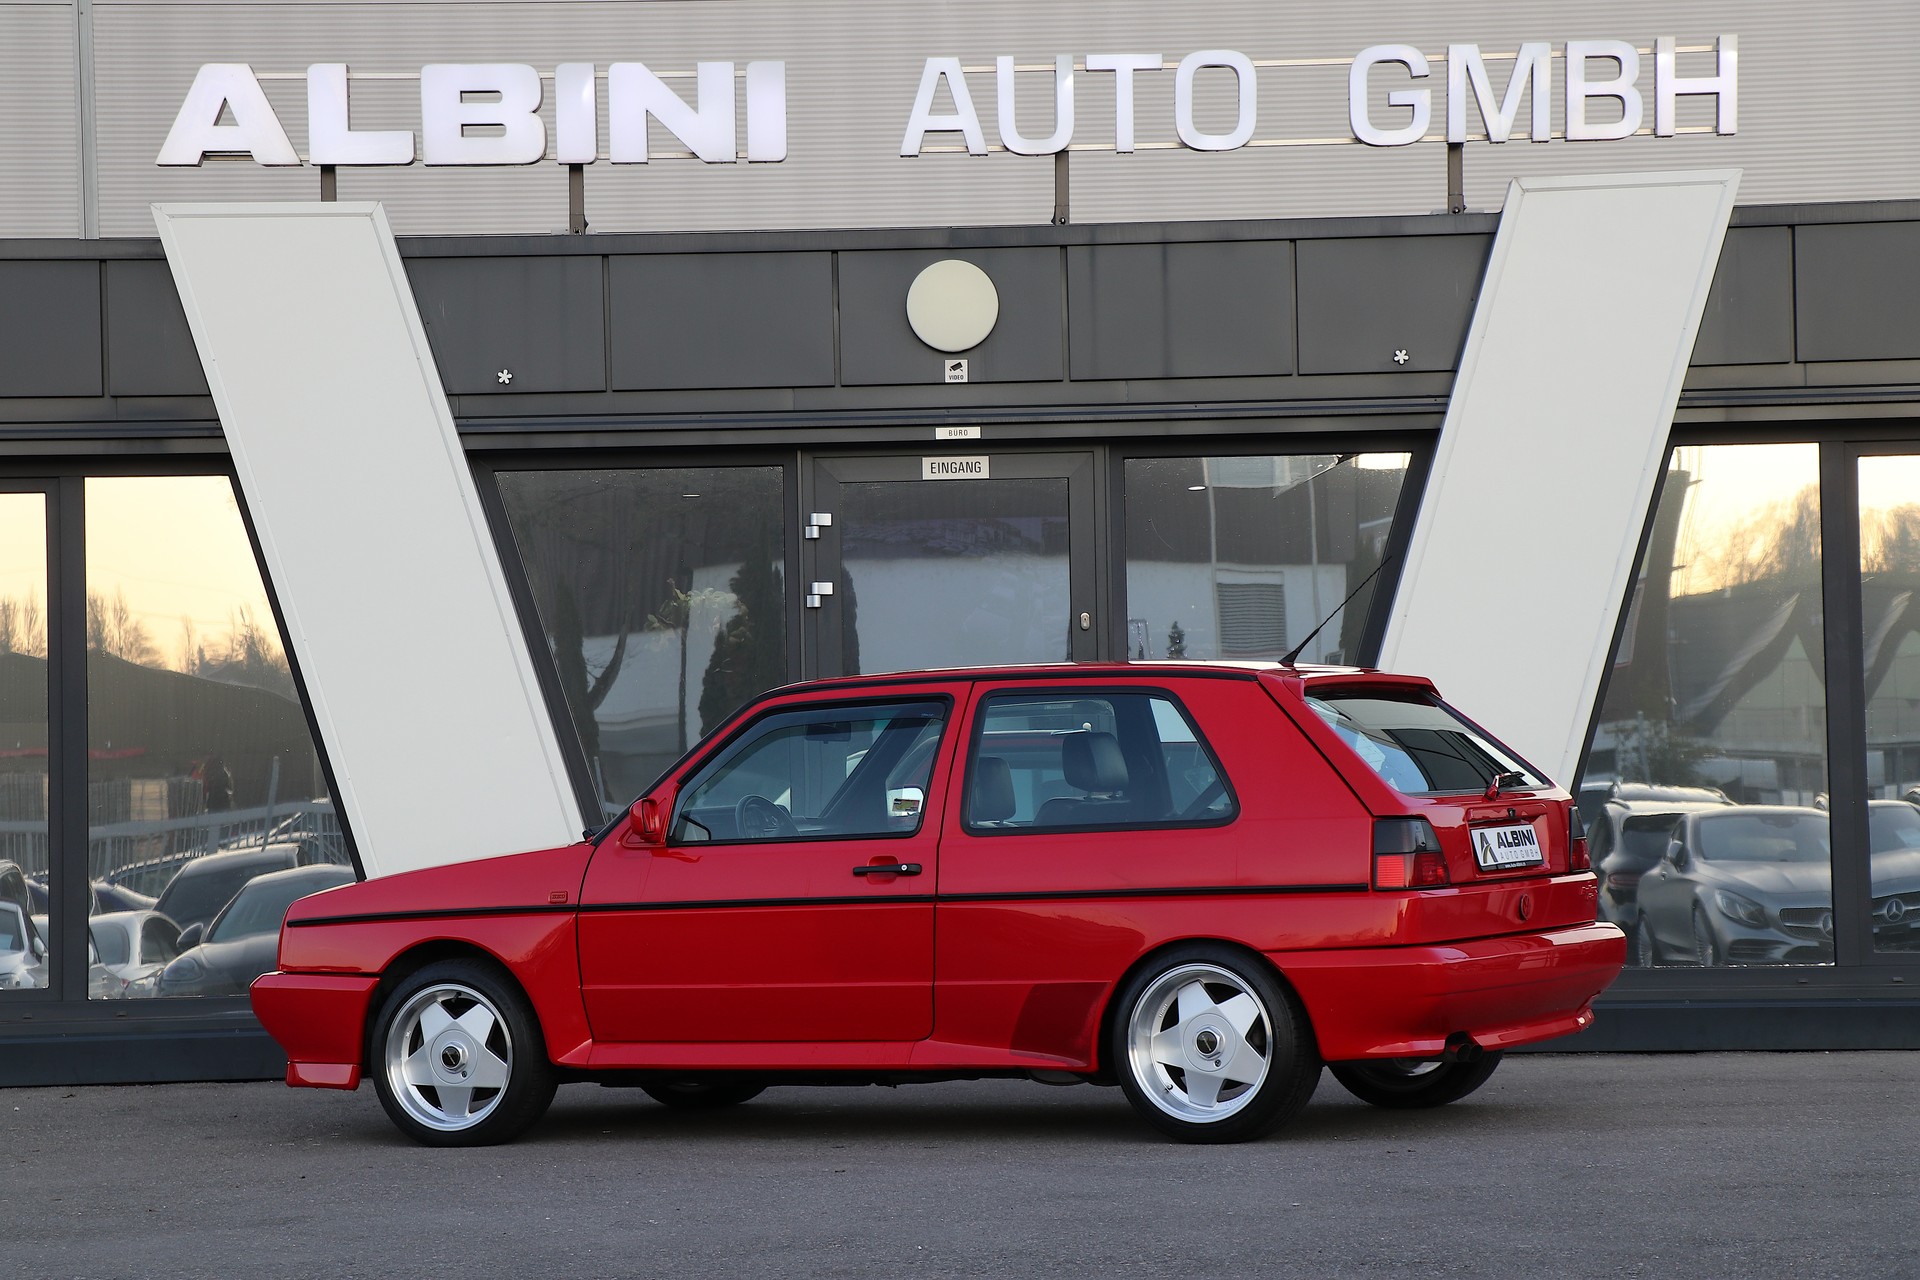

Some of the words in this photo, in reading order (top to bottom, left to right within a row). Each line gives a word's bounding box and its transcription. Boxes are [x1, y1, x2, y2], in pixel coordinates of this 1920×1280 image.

[156, 61, 787, 166] ALBINI
[900, 49, 1258, 157] AUTO
[1348, 34, 1739, 147] GMBH
[930, 461, 982, 474] EINGANG
[1496, 829, 1536, 849] ALBINI
[1500, 850, 1519, 860] AUTO
